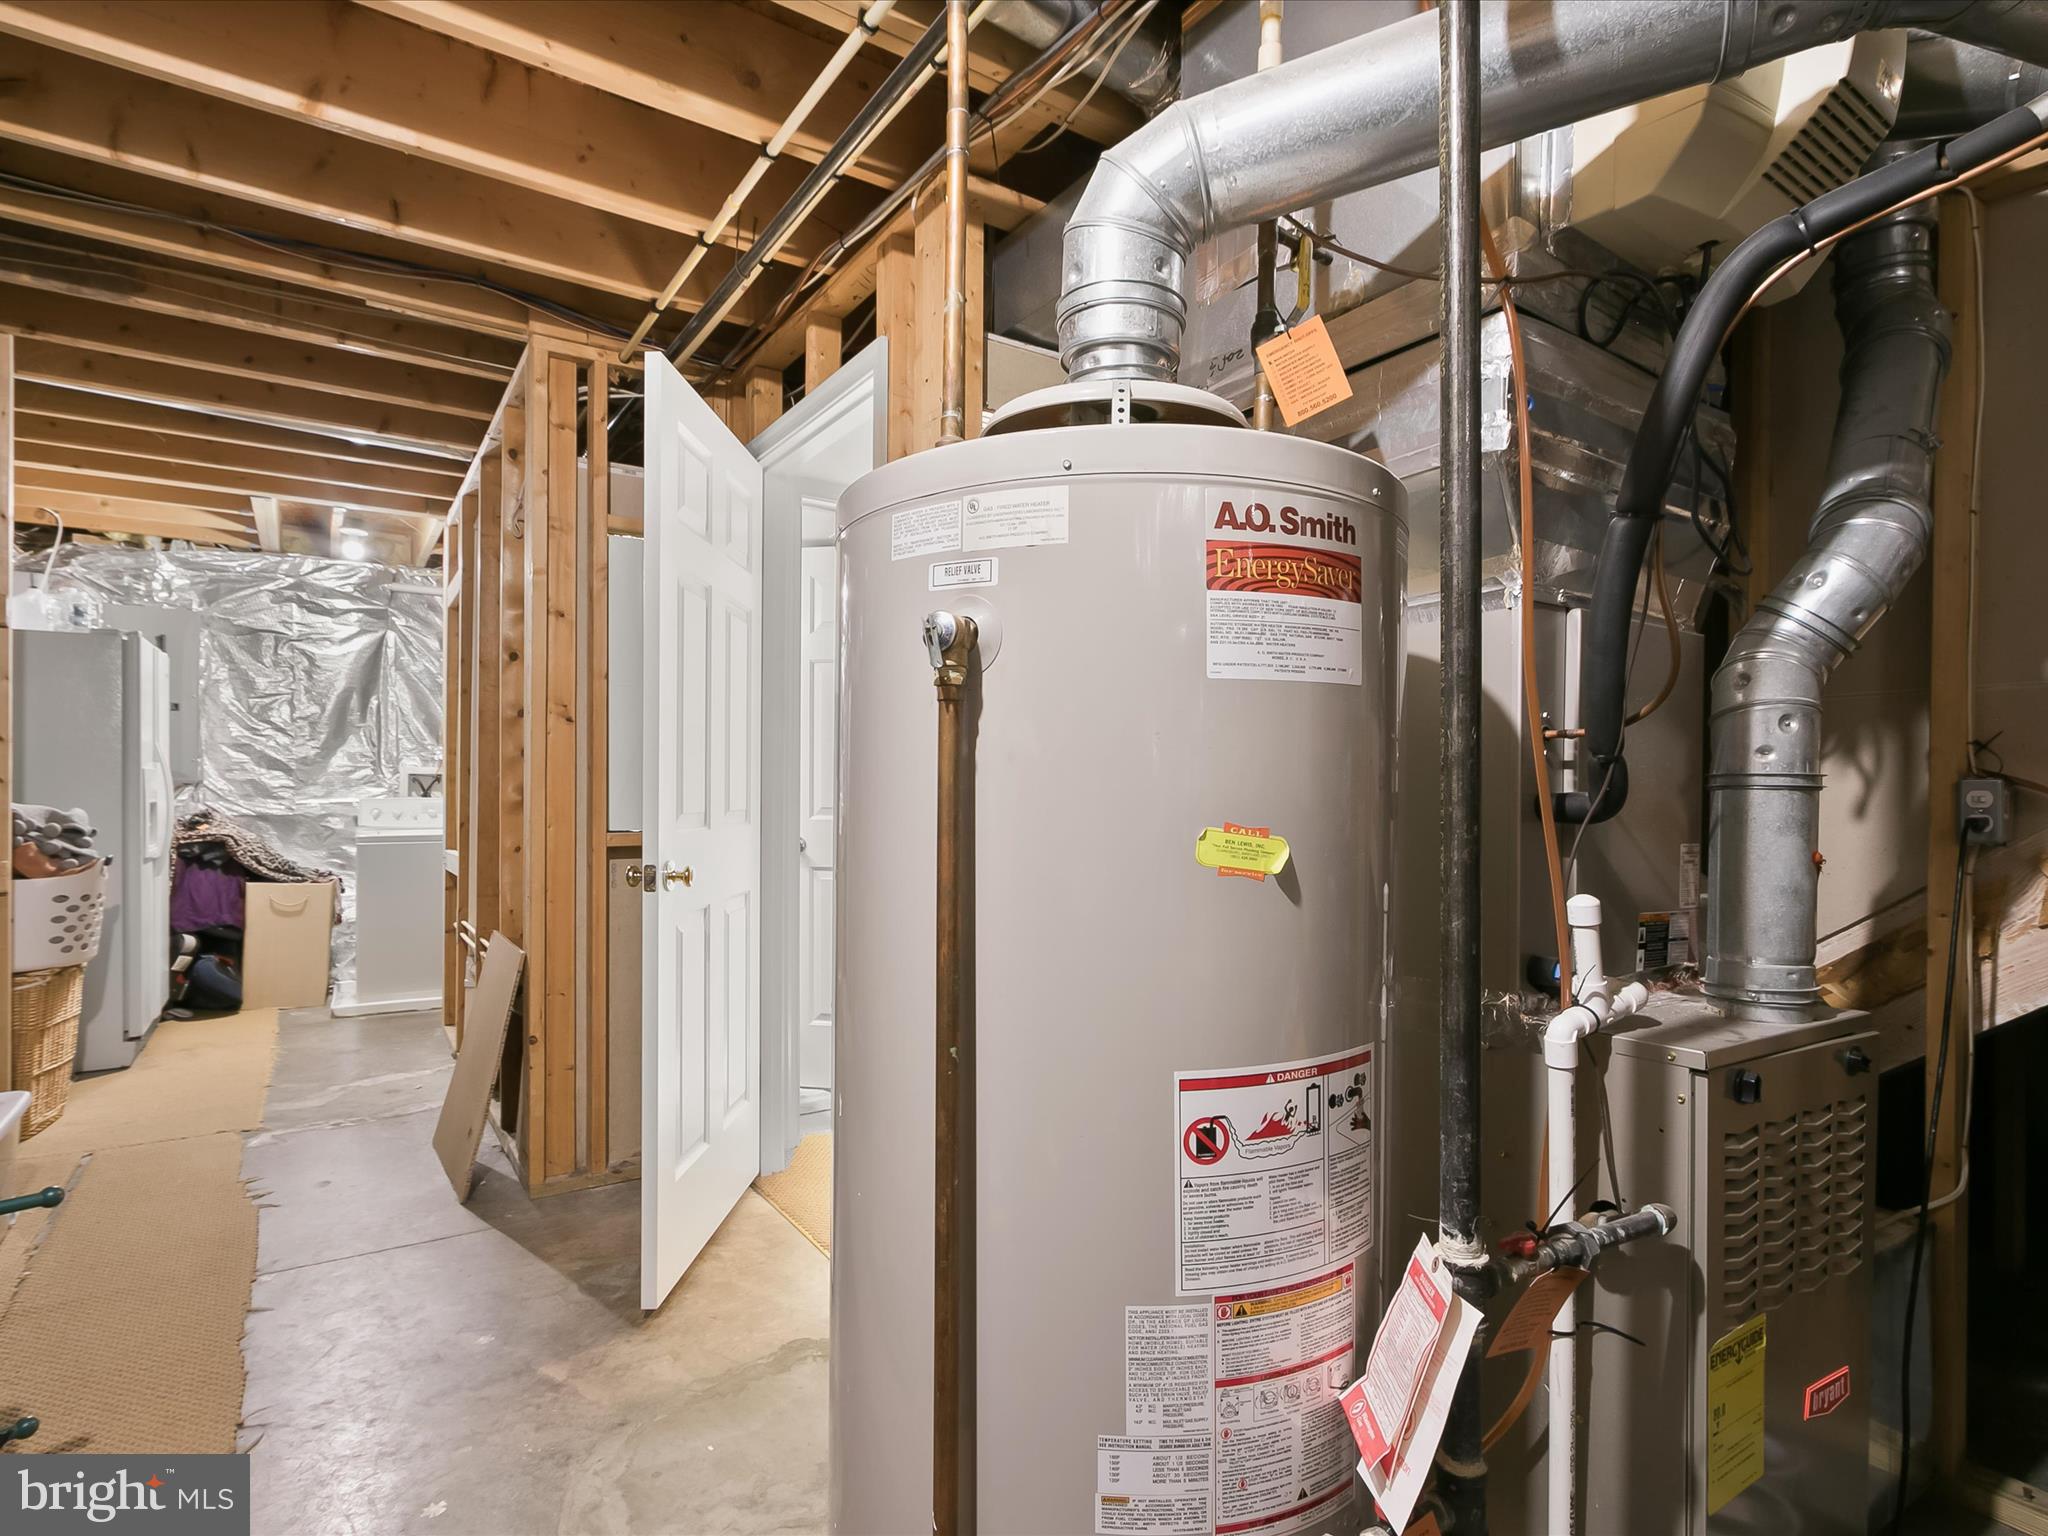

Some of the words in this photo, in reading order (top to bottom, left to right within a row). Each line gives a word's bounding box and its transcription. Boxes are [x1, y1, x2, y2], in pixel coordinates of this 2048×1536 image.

[1214, 501, 1276, 533] A.O.
[1279, 506, 1356, 545] Smith
[944, 565, 962, 577] RELIEF
[963, 563, 982, 575] VALVE
[1215, 548, 1354, 590] EnergySaver
[1230, 827, 1263, 837] CALL
[1277, 1067, 1318, 1082] DANGER
[1245, 1146, 1273, 1154] Flammable
[1274, 1143, 1291, 1151] Vapors
[1812, 1376, 1846, 1412] bryant
